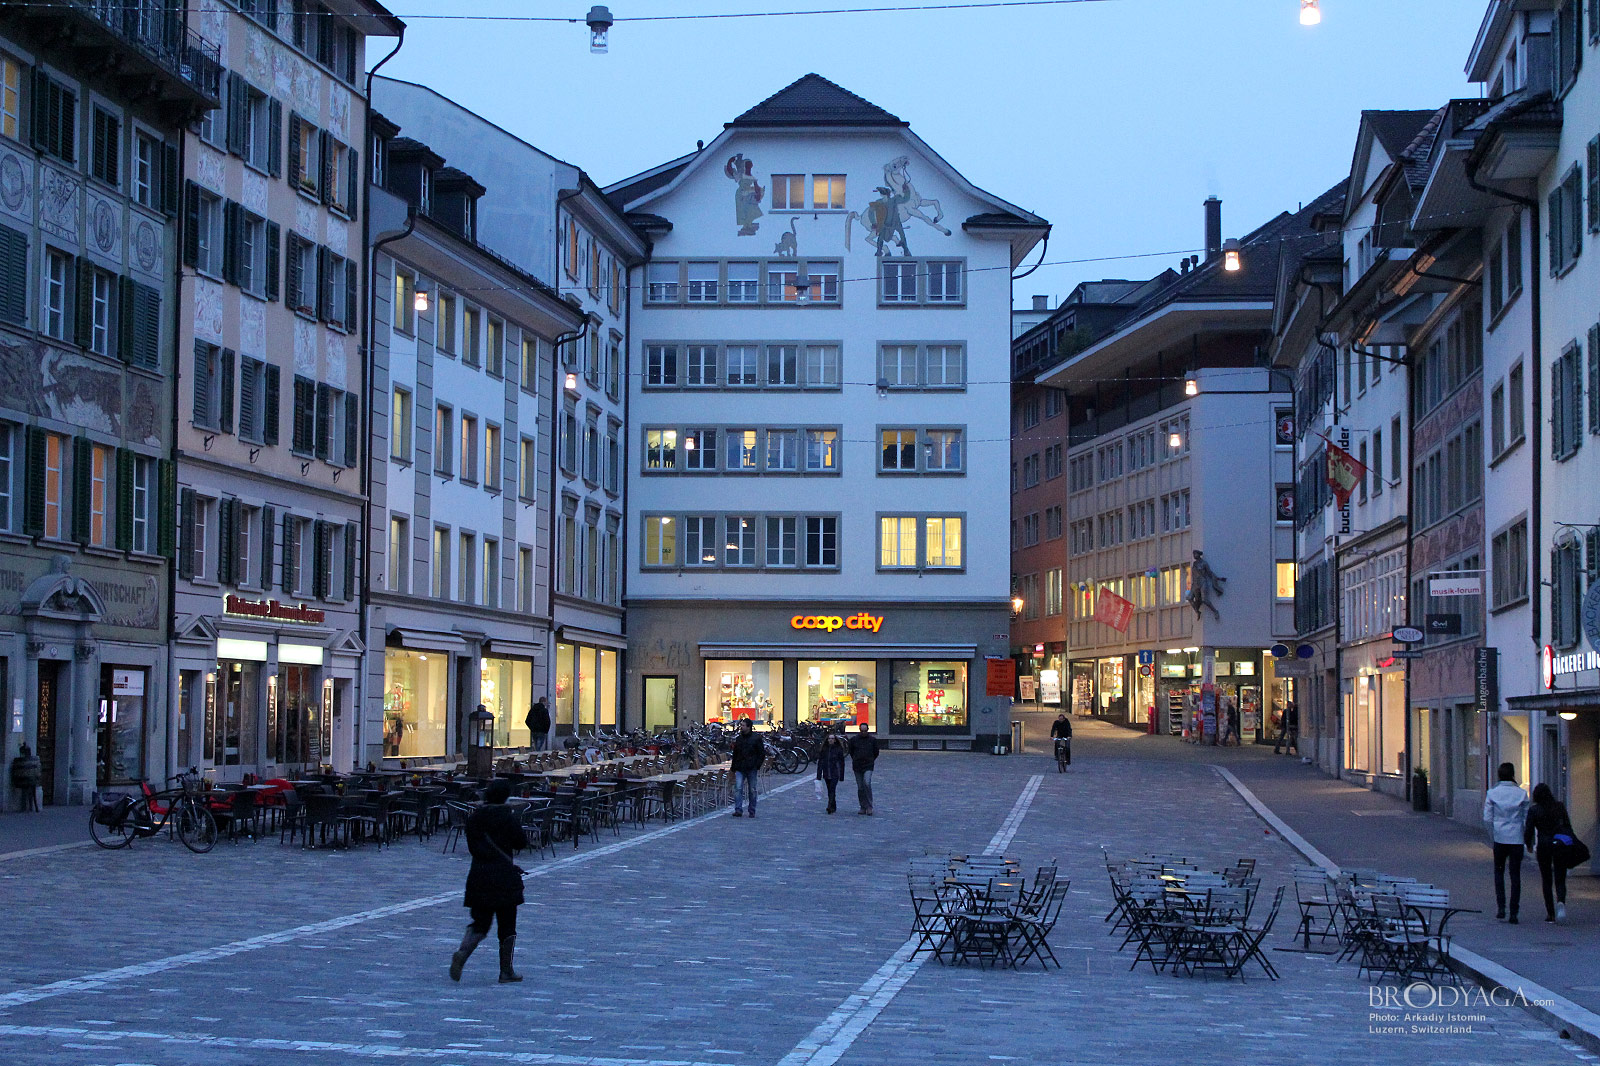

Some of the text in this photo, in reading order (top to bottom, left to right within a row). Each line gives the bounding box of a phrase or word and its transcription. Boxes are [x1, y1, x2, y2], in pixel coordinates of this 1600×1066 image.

[1431, 587, 1480, 595] musik-forum
[790, 612, 884, 633] coop city
[1552, 653, 1585, 675] BÄCKEREI
[1478, 649, 1490, 711] Langenbacher
